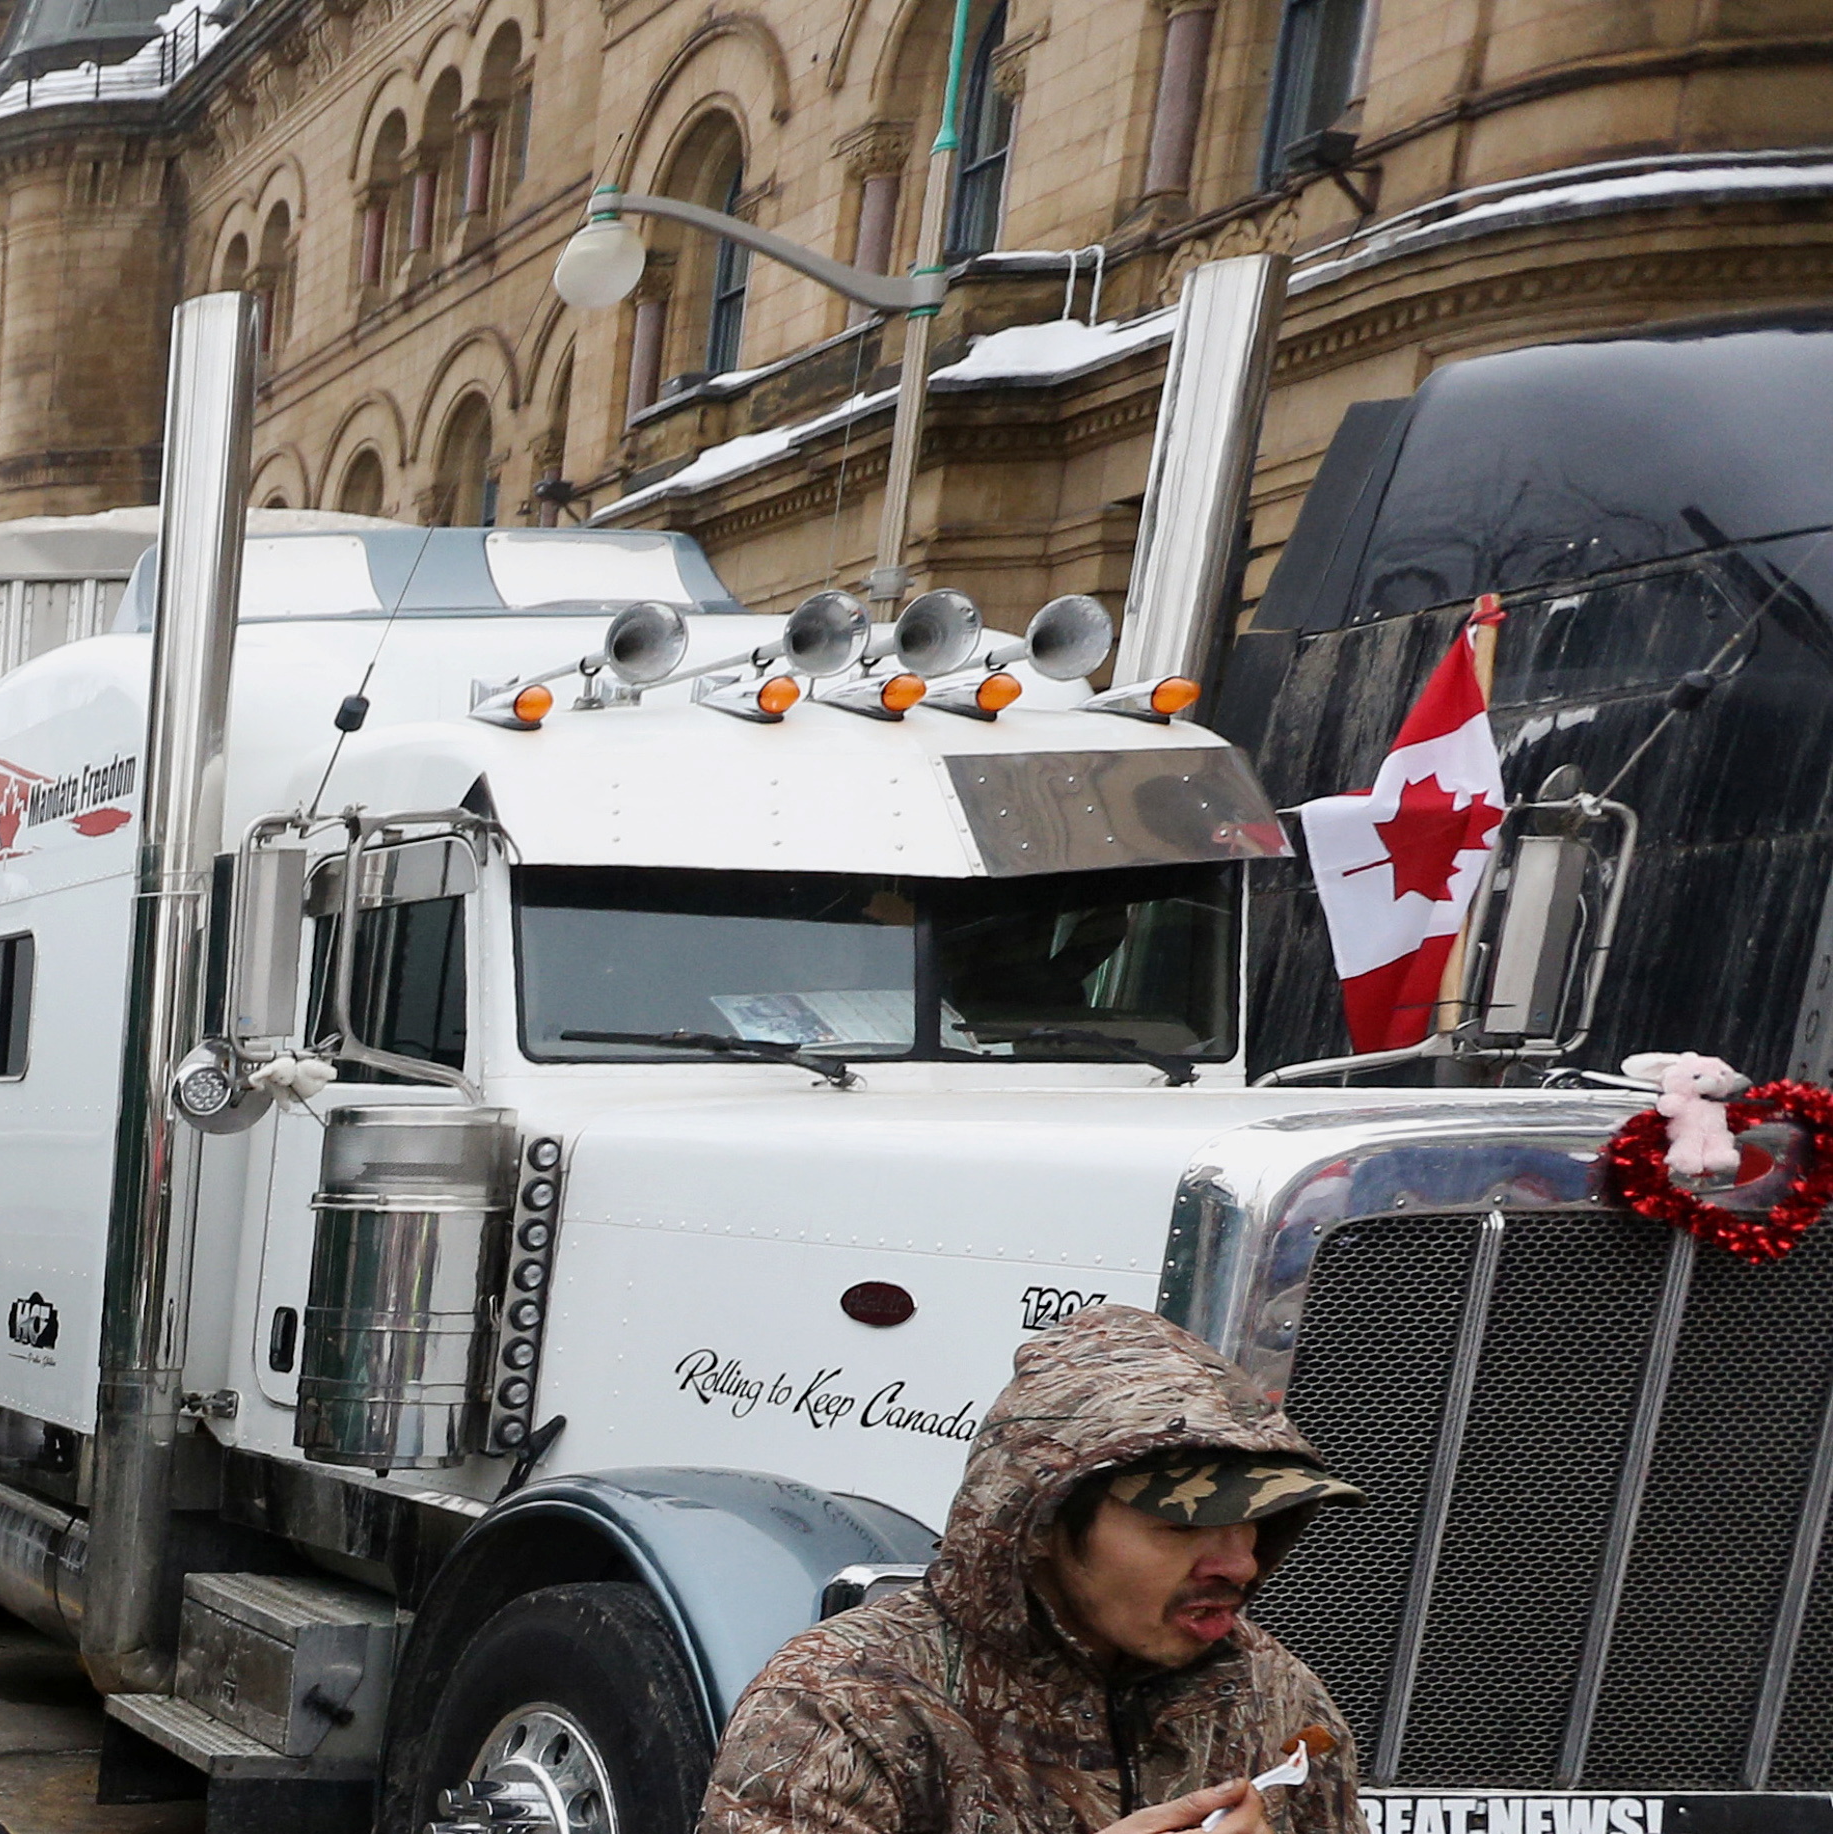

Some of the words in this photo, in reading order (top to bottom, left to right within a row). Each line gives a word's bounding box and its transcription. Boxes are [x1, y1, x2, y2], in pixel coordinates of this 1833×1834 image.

[28, 773, 78, 828] Mandate
[81, 753, 137, 812] Freedom
[674, 1348, 767, 1418] Rolling
[766, 1375, 792, 1406] to
[792, 1367, 855, 1429] Keep
[859, 1381, 976, 1444] Canada
